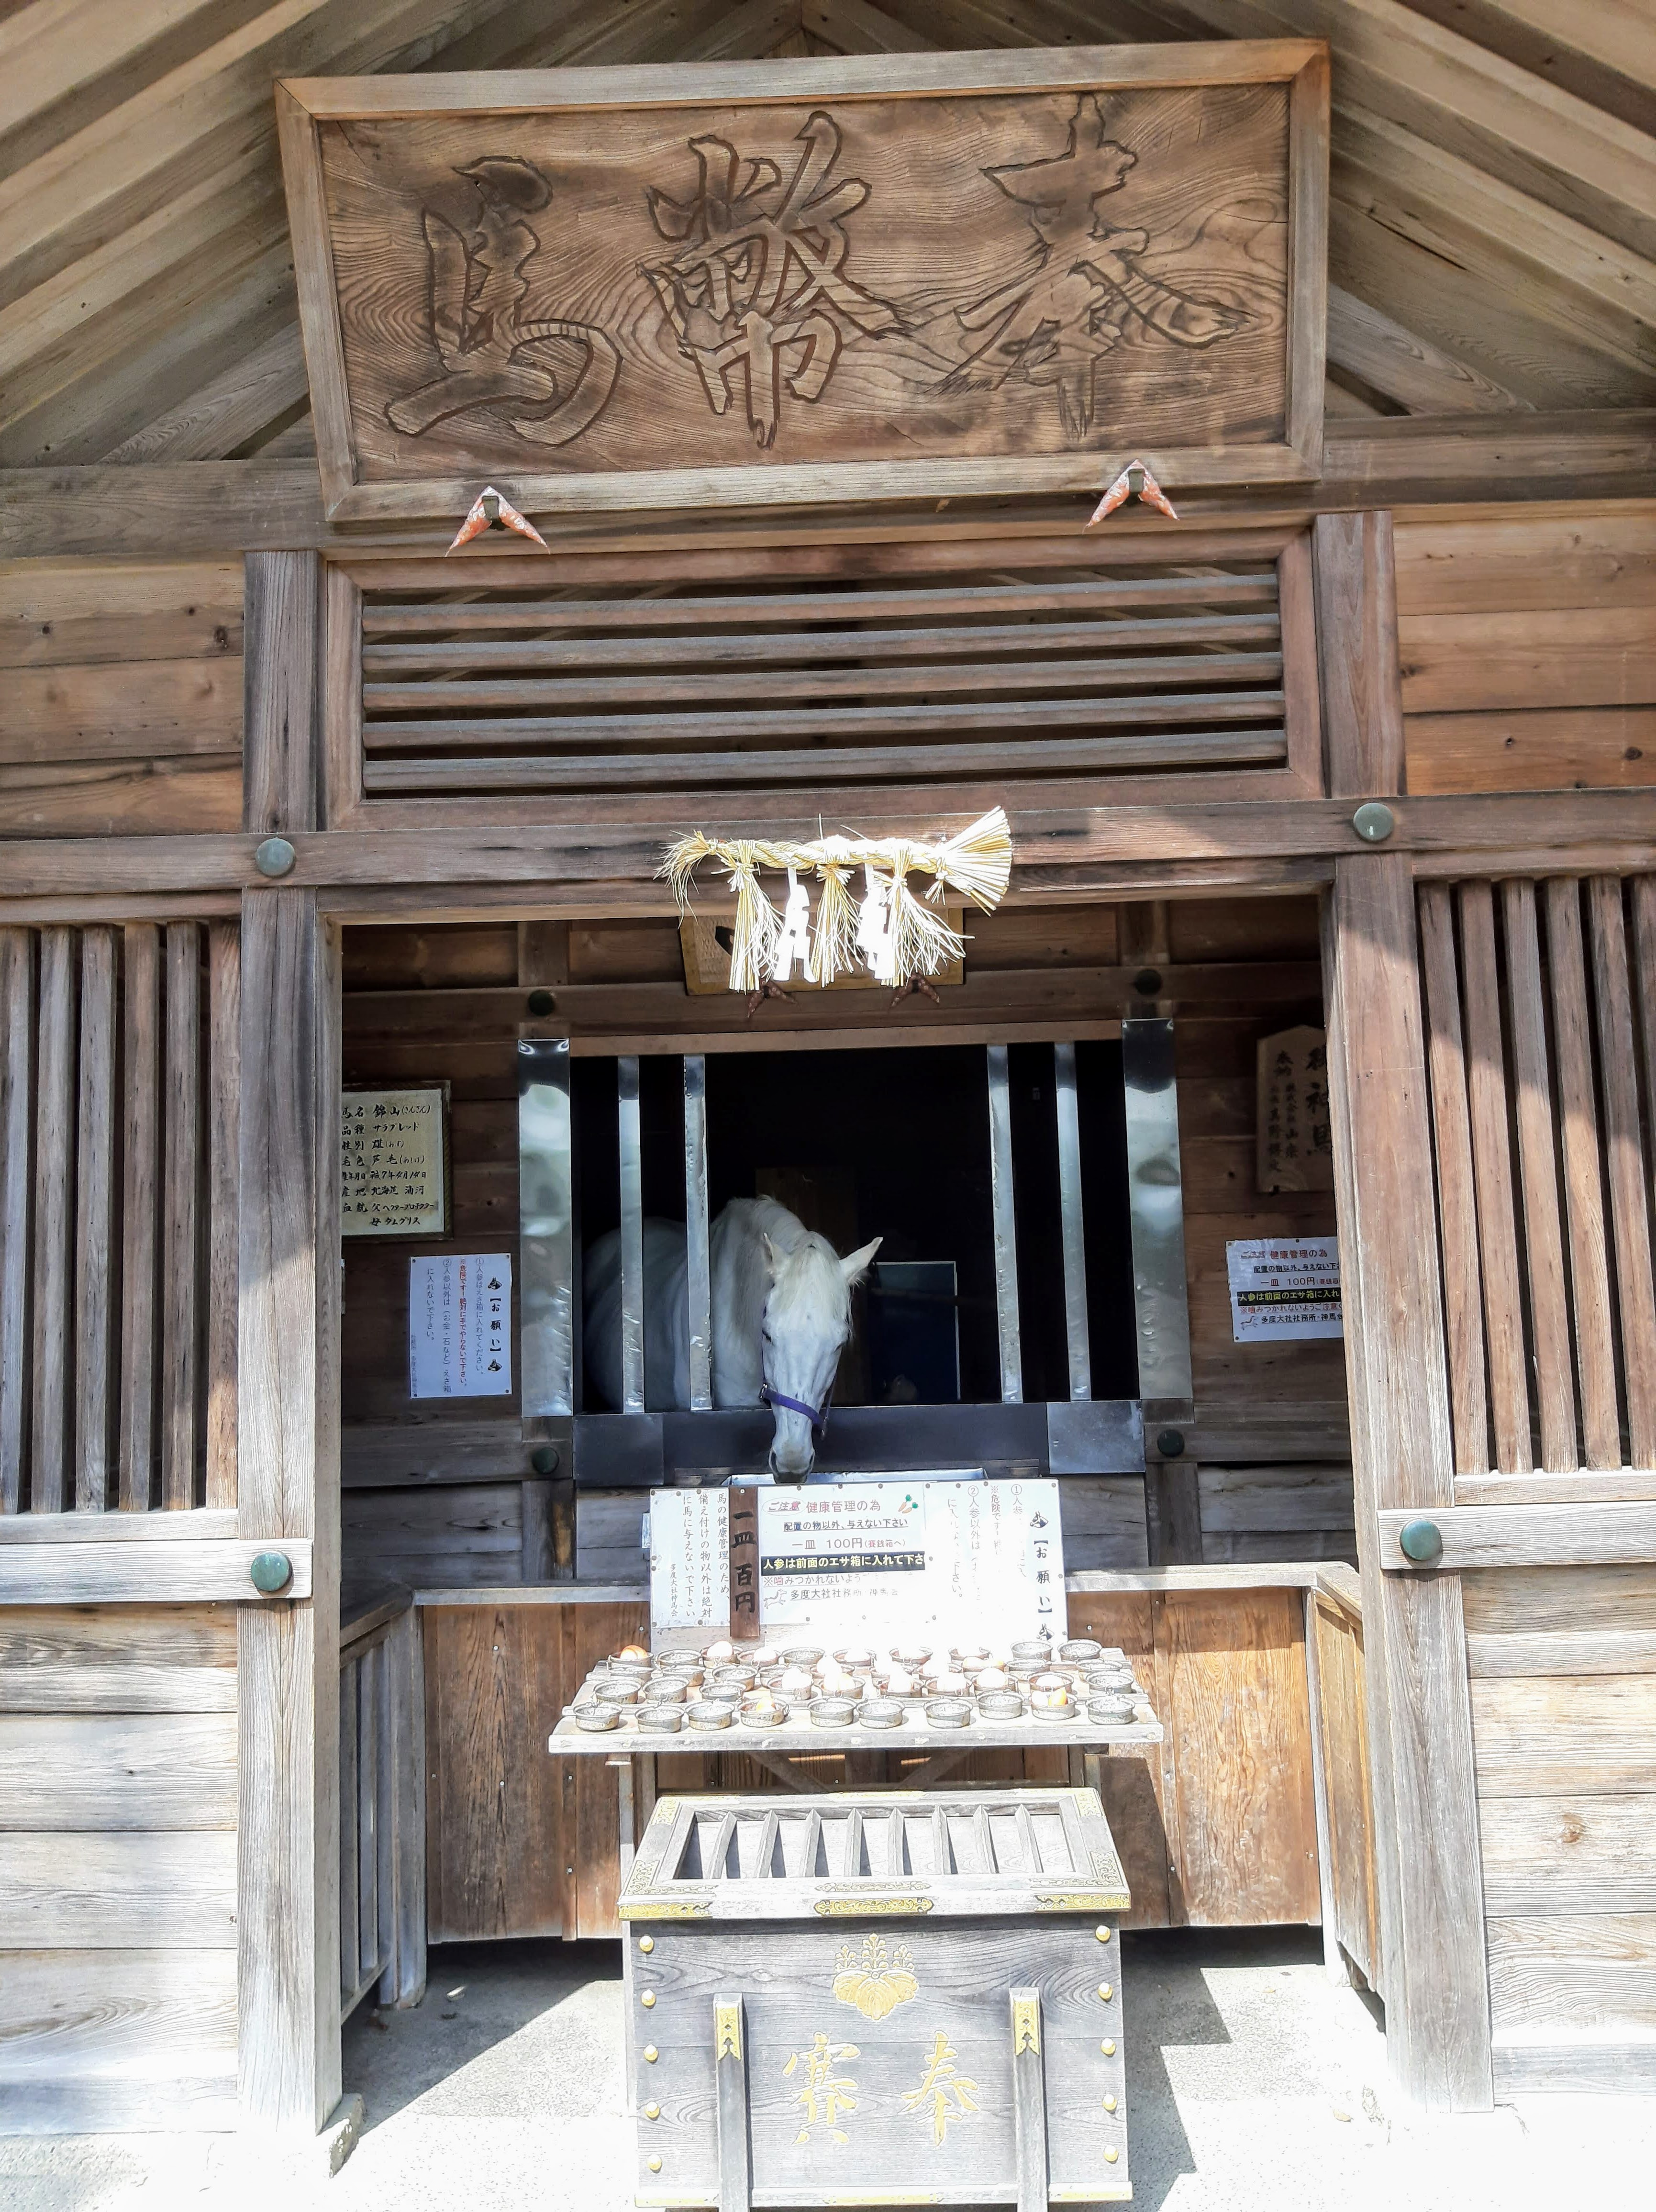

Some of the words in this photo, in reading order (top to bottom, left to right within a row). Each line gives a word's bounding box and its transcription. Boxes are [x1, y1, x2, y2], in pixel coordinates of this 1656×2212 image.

[1270, 1249, 1328, 1259] 健康管理の為
[767, 1501, 801, 1512] ご注意
[806, 1499, 881, 1513] 健康管理の為
[784, 1518, 908, 1531] 配置の物以外、与えない下さい
